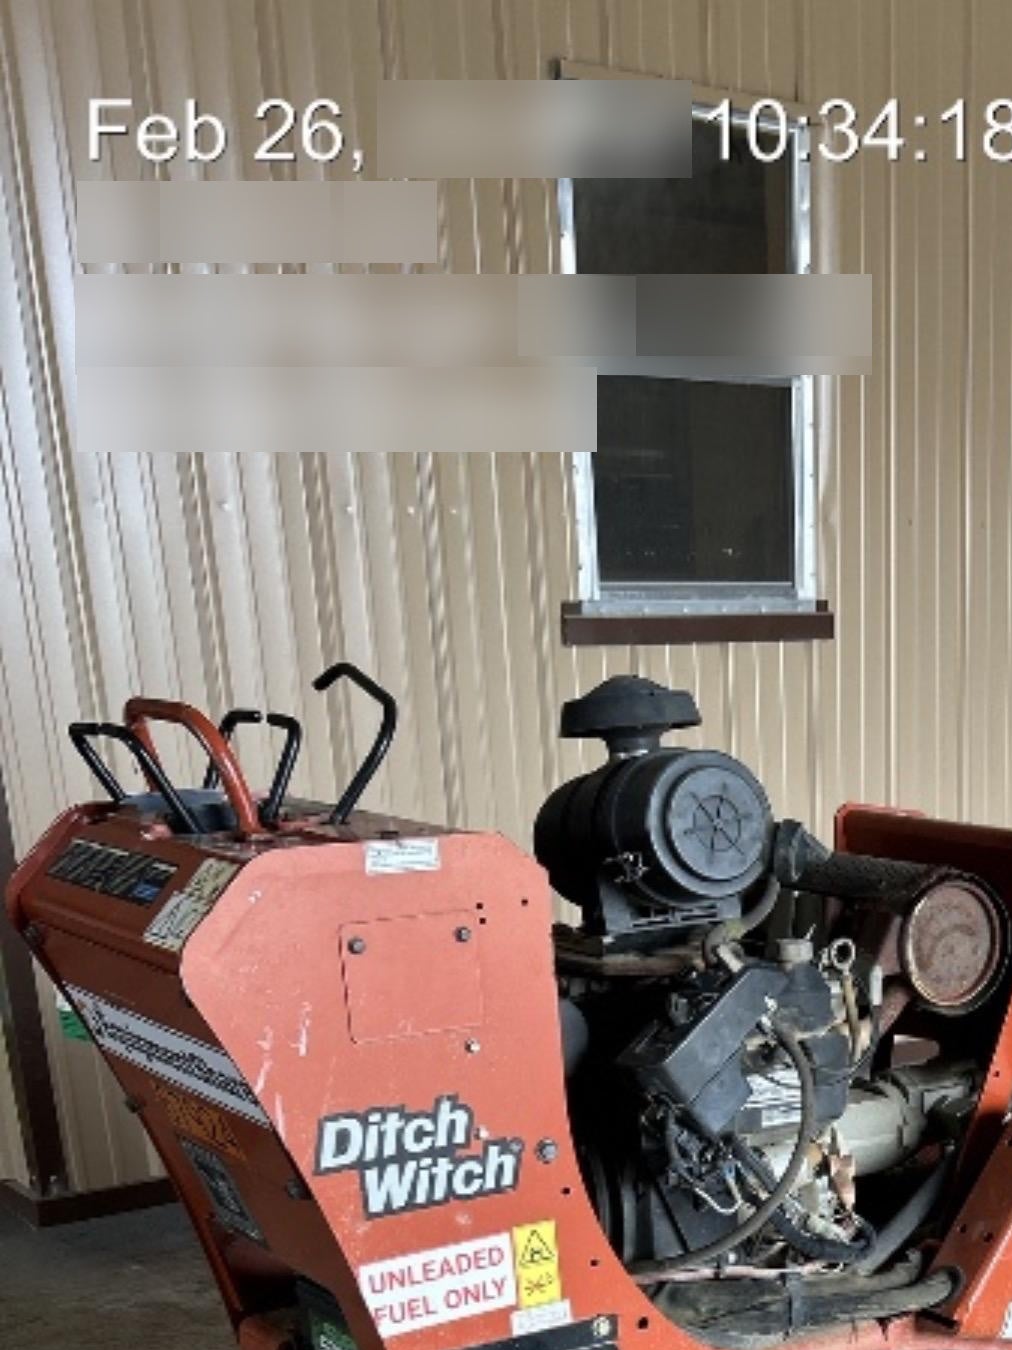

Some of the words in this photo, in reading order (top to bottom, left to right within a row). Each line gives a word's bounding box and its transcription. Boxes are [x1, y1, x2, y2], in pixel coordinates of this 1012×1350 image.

[318, 1096, 470, 1170] Ditch
[363, 1143, 519, 1214] Witch
[368, 1246, 505, 1294] UNLEADED
[373, 1299, 439, 1325] FUEL
[443, 1276, 507, 1310] ONLY
